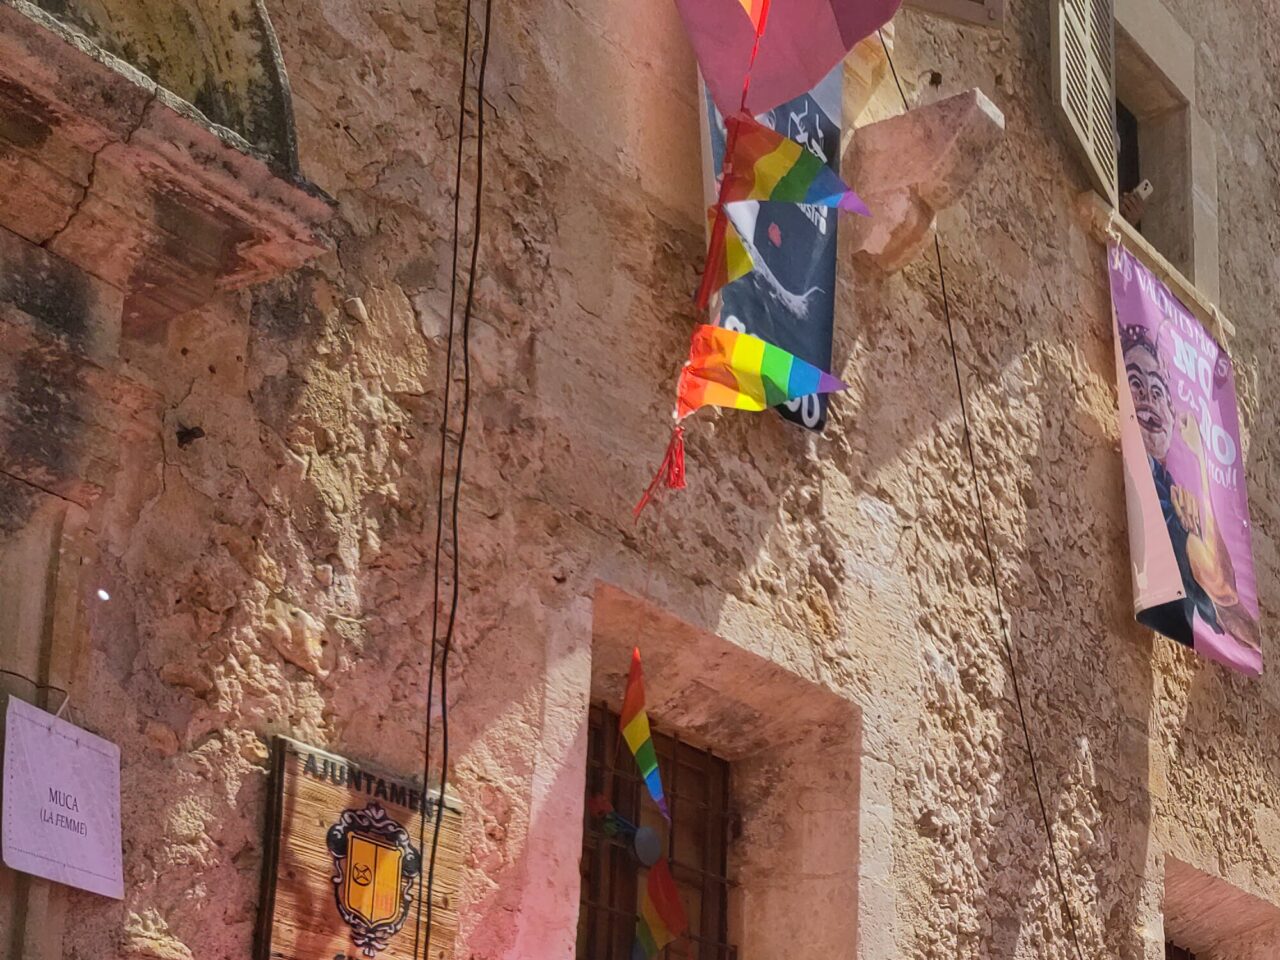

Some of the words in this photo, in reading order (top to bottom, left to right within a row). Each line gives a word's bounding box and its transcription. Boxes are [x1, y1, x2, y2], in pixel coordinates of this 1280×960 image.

[1171, 328, 1214, 399] NO
[48, 787, 79, 813] MUCA
[303, 752, 444, 824] AJUNTAMEN
[40, 807, 54, 826] (LA
[55, 814, 88, 838] FEMME)
